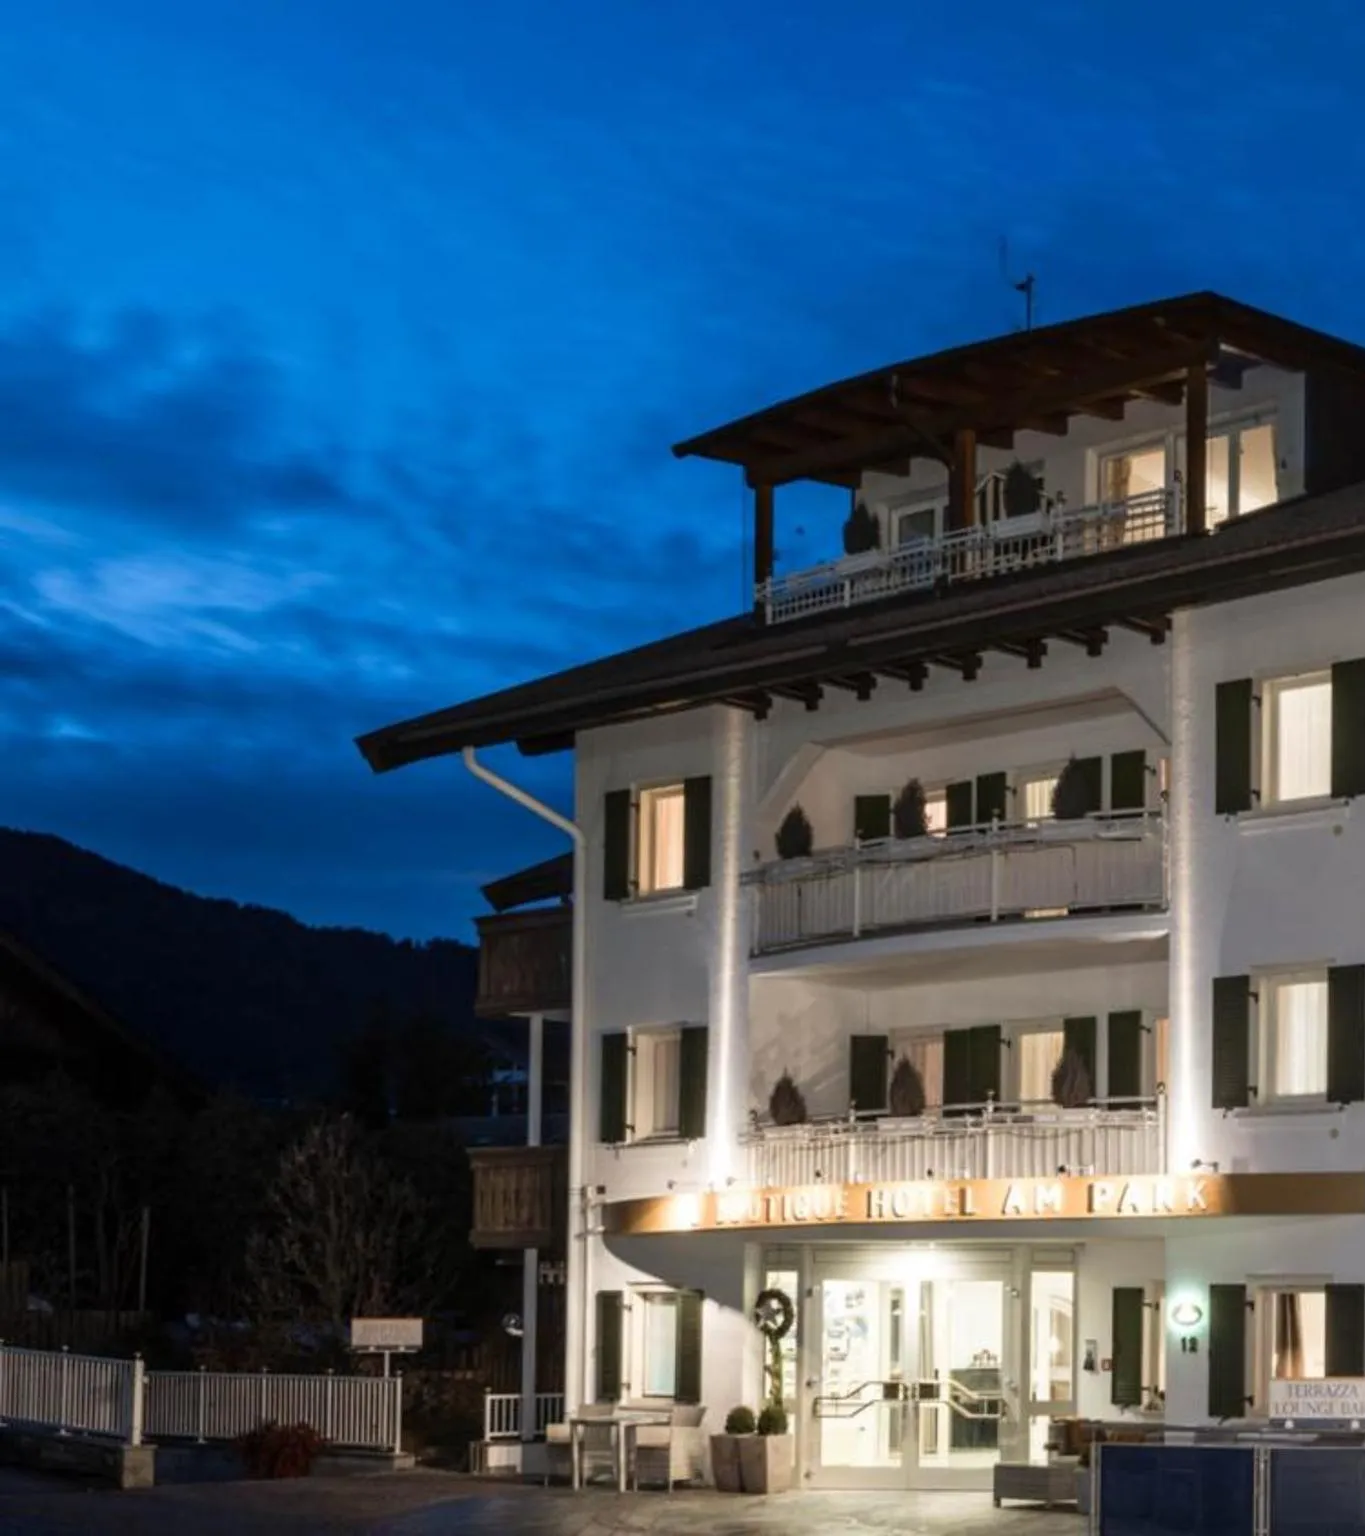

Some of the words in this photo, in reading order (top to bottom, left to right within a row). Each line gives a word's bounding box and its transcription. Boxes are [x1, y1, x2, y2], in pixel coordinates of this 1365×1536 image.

[714, 1187, 849, 1226] UTIQUE
[866, 1186, 978, 1219] HOTEL
[1001, 1182, 1064, 1216] AM
[1087, 1179, 1207, 1215] PARK
[1181, 1336, 1198, 1353] 12
[1287, 1383, 1359, 1399] TERRAZZA
[1274, 1401, 1334, 1415] LOUNGE
